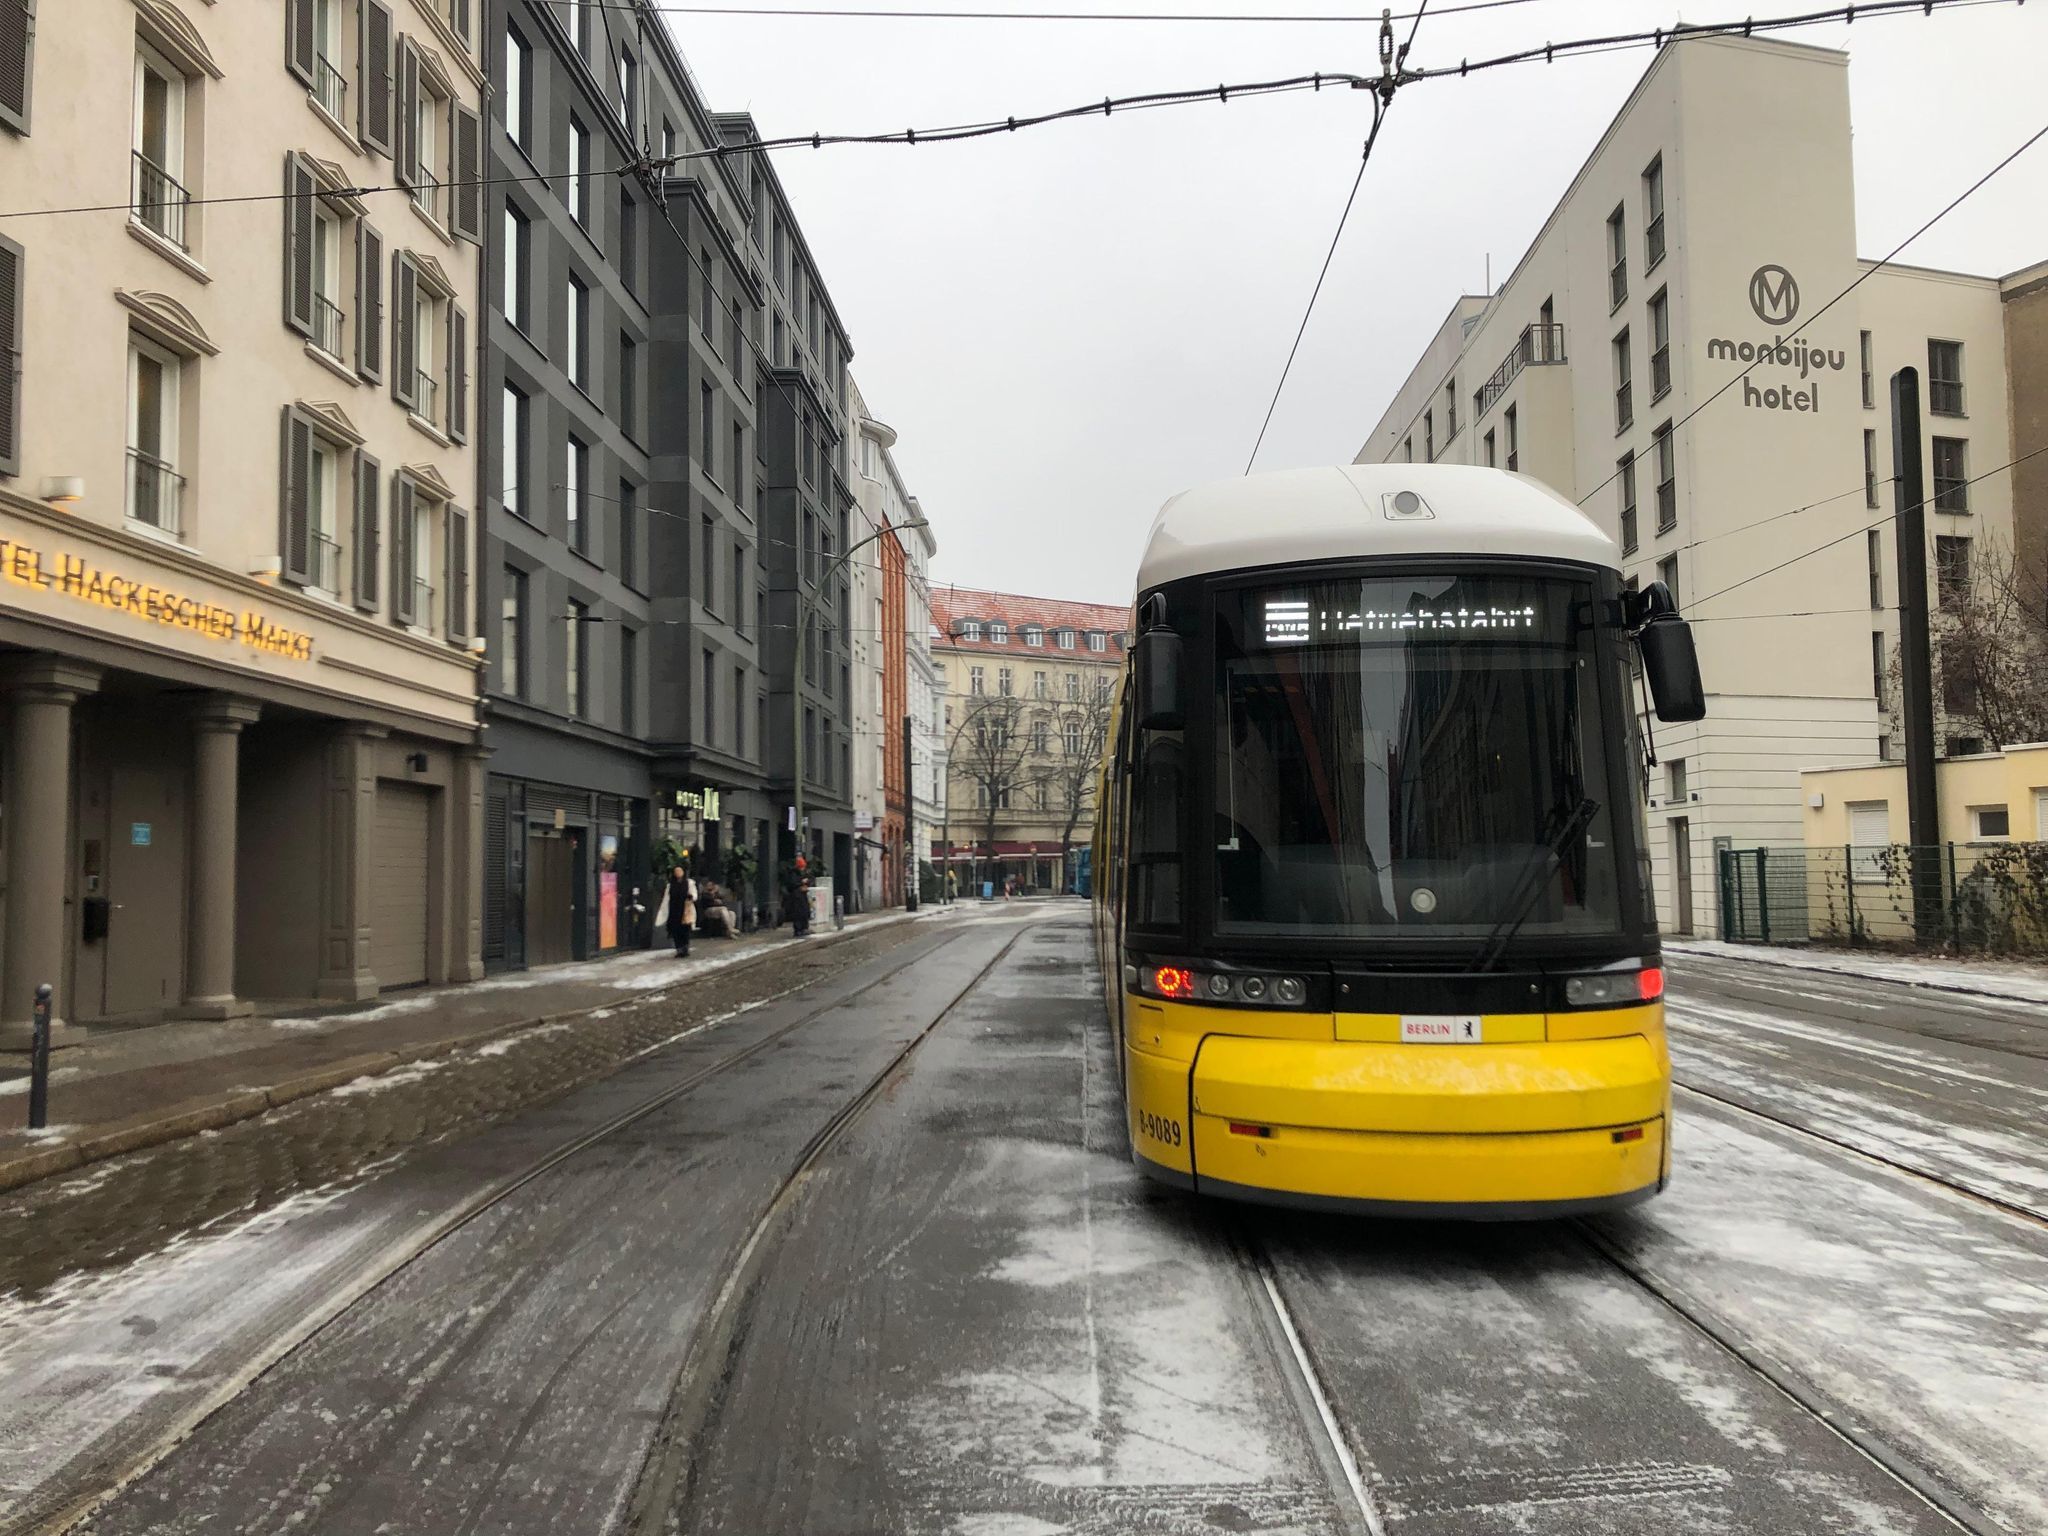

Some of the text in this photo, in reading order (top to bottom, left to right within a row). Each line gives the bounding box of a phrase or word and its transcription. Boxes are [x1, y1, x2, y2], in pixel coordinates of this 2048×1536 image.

[1707, 335, 1845, 379] monbijou
[1744, 376, 1818, 413] hotel
[63, 553, 237, 640] HACKESCHER
[247, 612, 315, 660] MARKT
[1406, 1023, 1451, 1035] BERLIN
